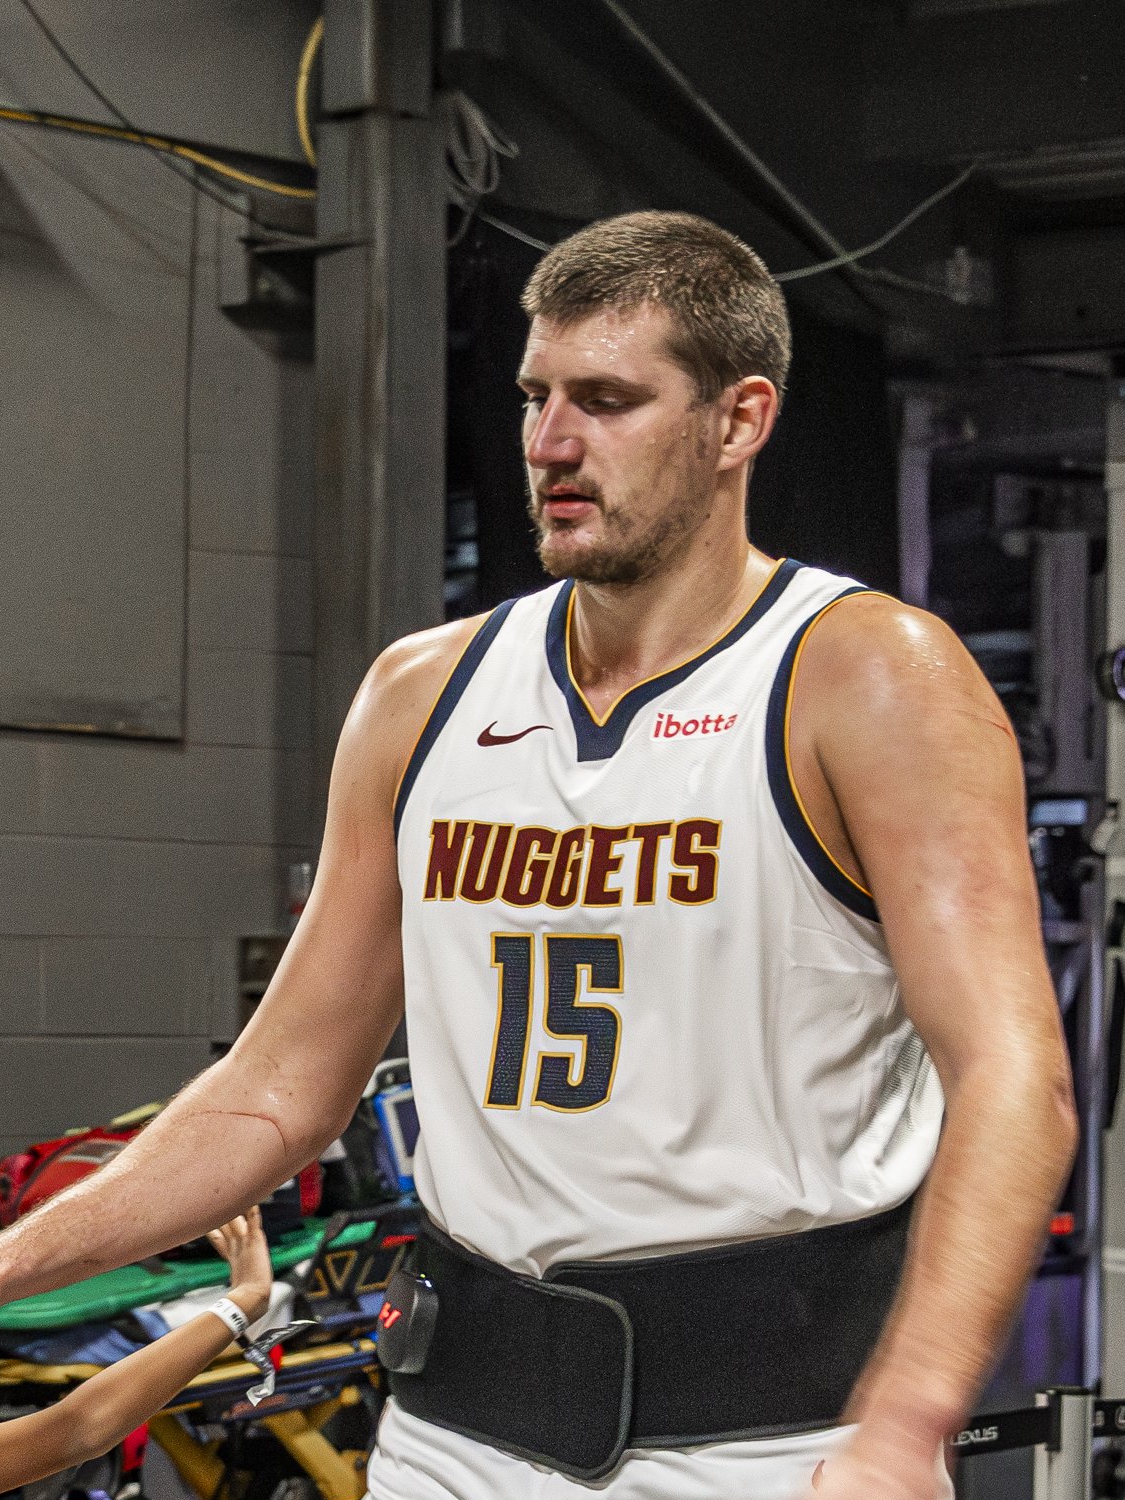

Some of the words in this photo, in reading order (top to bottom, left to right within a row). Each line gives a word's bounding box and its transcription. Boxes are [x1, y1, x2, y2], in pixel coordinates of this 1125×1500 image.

[653, 712, 738, 738] ibotta
[423, 817, 723, 910] NUGGETS
[483, 931, 625, 1114] 15
